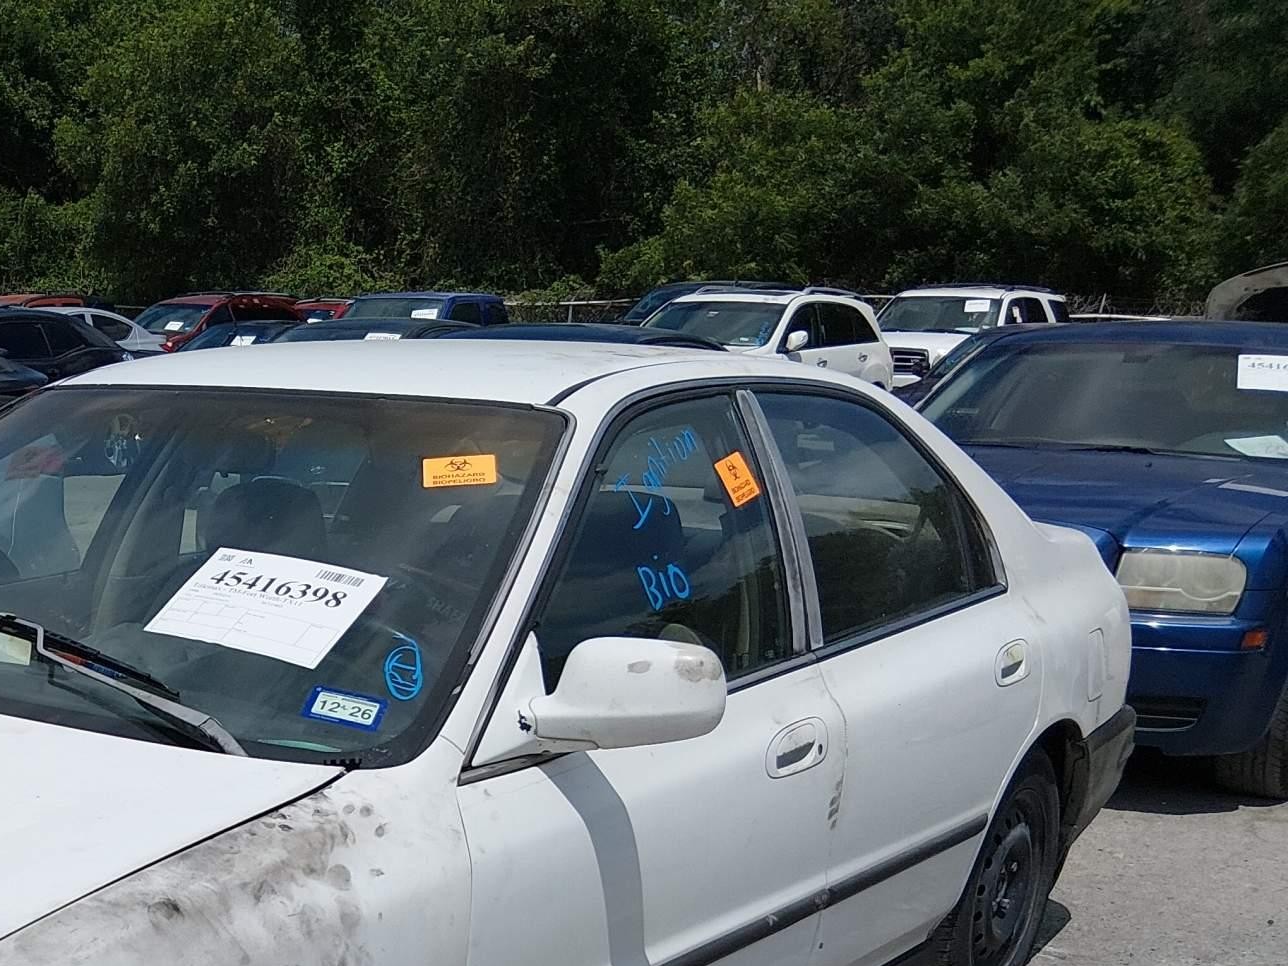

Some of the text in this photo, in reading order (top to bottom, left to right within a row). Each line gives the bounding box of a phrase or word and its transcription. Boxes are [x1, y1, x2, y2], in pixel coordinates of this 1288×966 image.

[210, 569, 348, 608] 45416398
[319, 700, 341, 713] 12
[348, 705, 374, 720] 26
